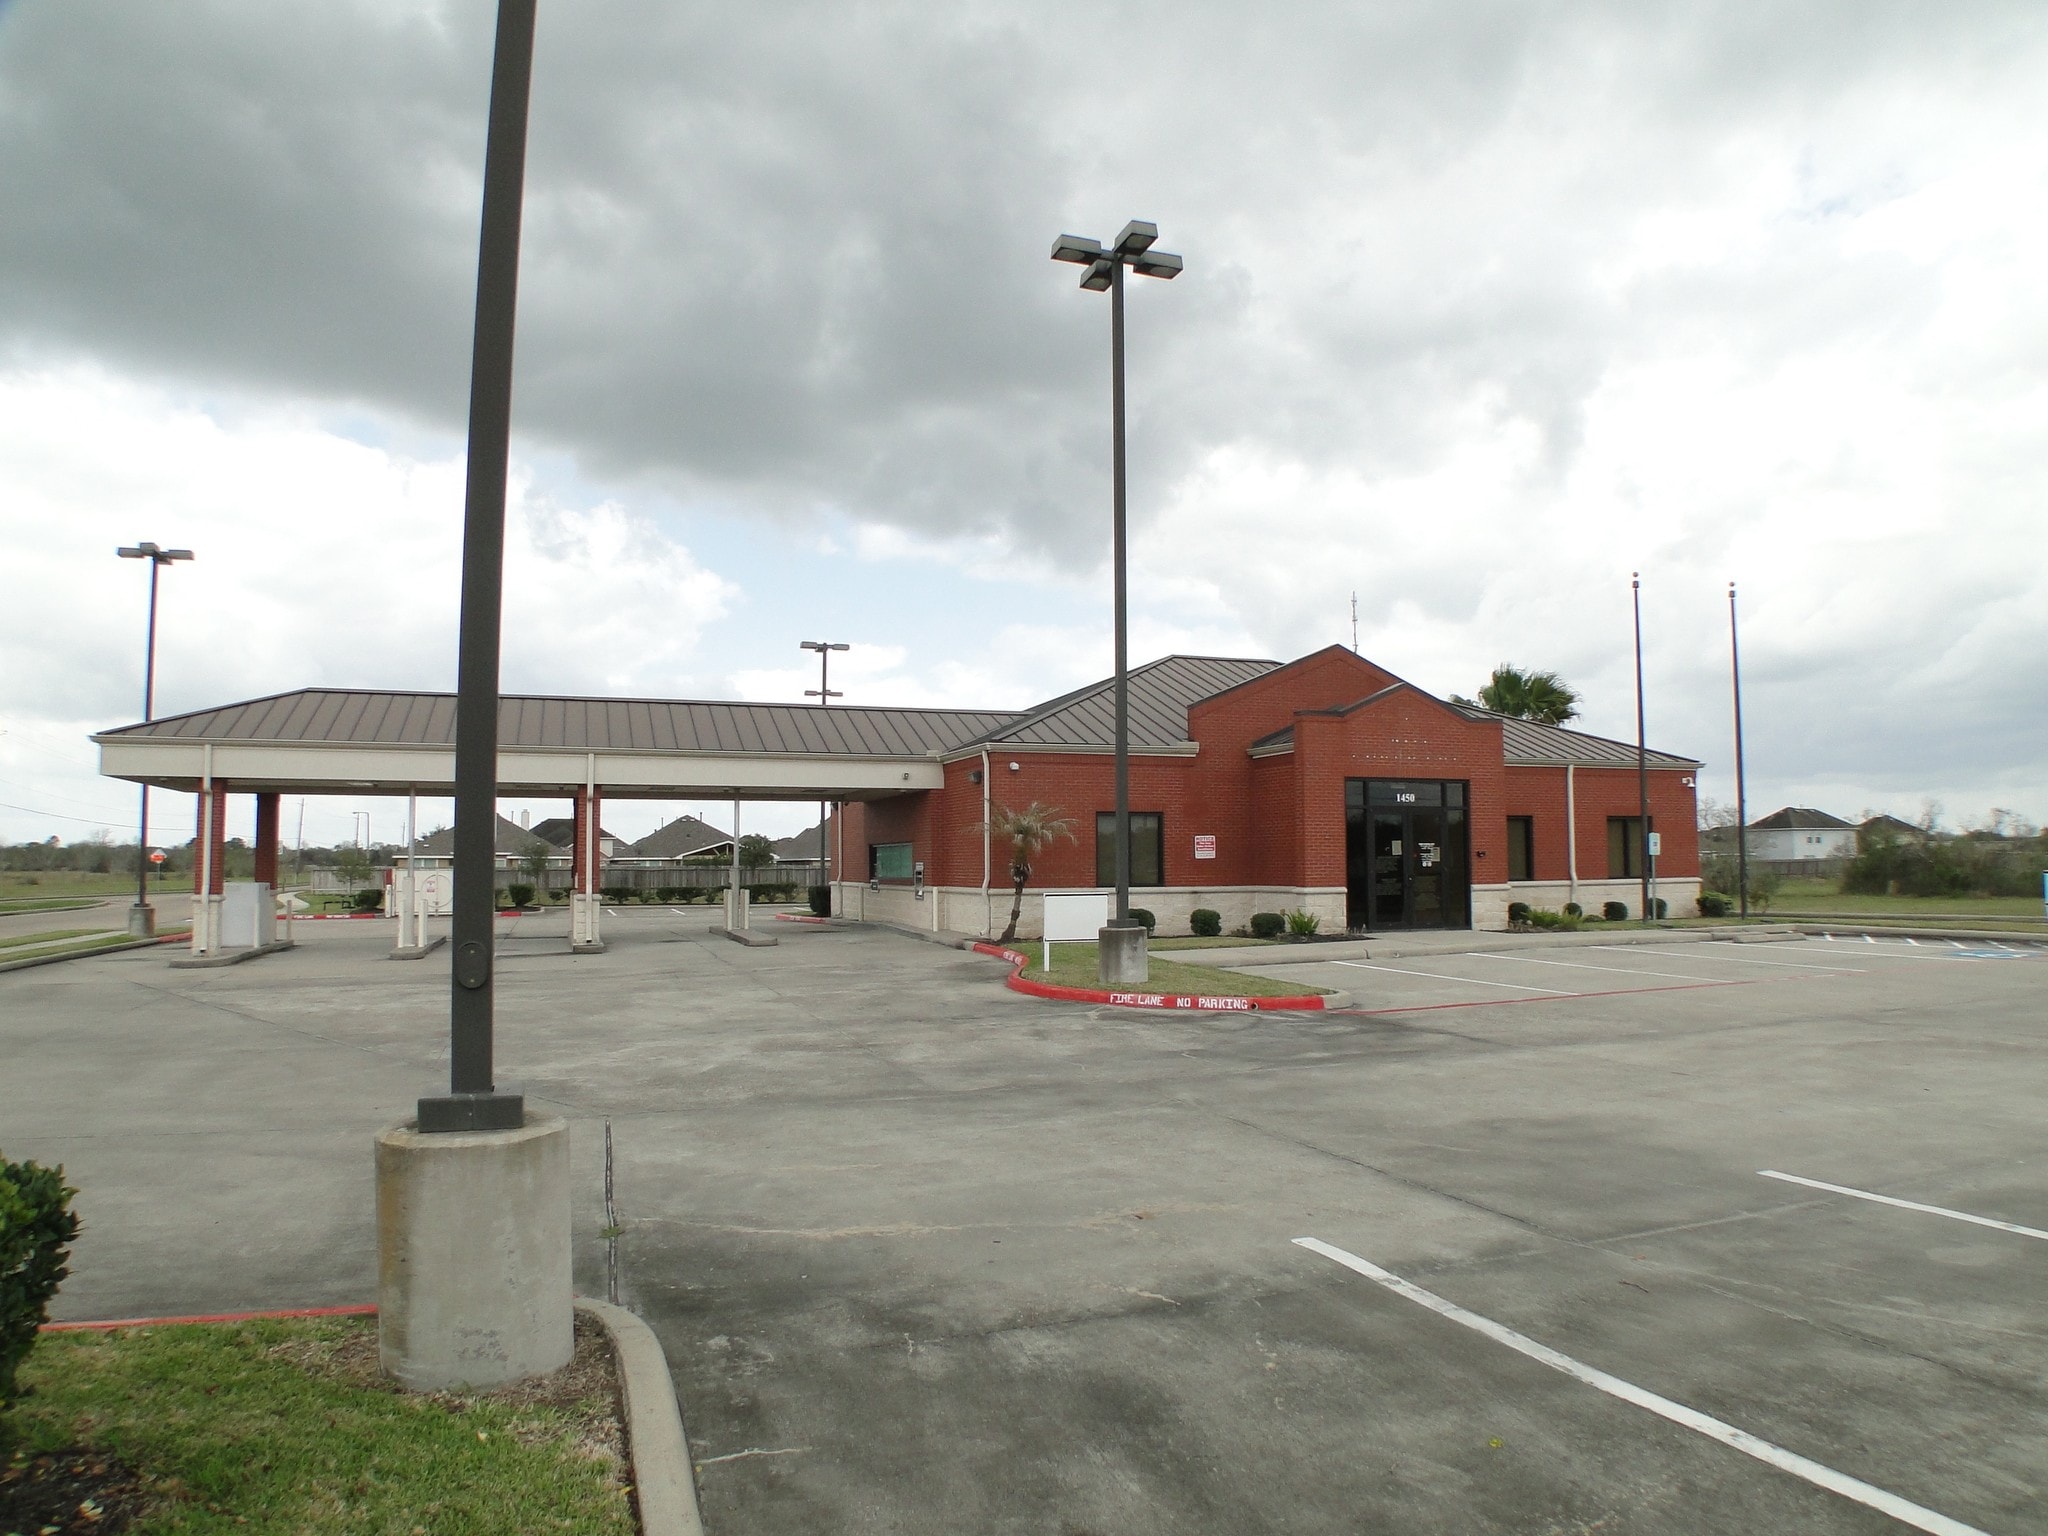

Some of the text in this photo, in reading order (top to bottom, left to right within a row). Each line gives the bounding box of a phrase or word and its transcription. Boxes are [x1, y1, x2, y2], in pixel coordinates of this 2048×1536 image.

[1396, 793, 1415, 802] 1450
[1110, 993, 1248, 1010] FIRE LANE NO PARKING
